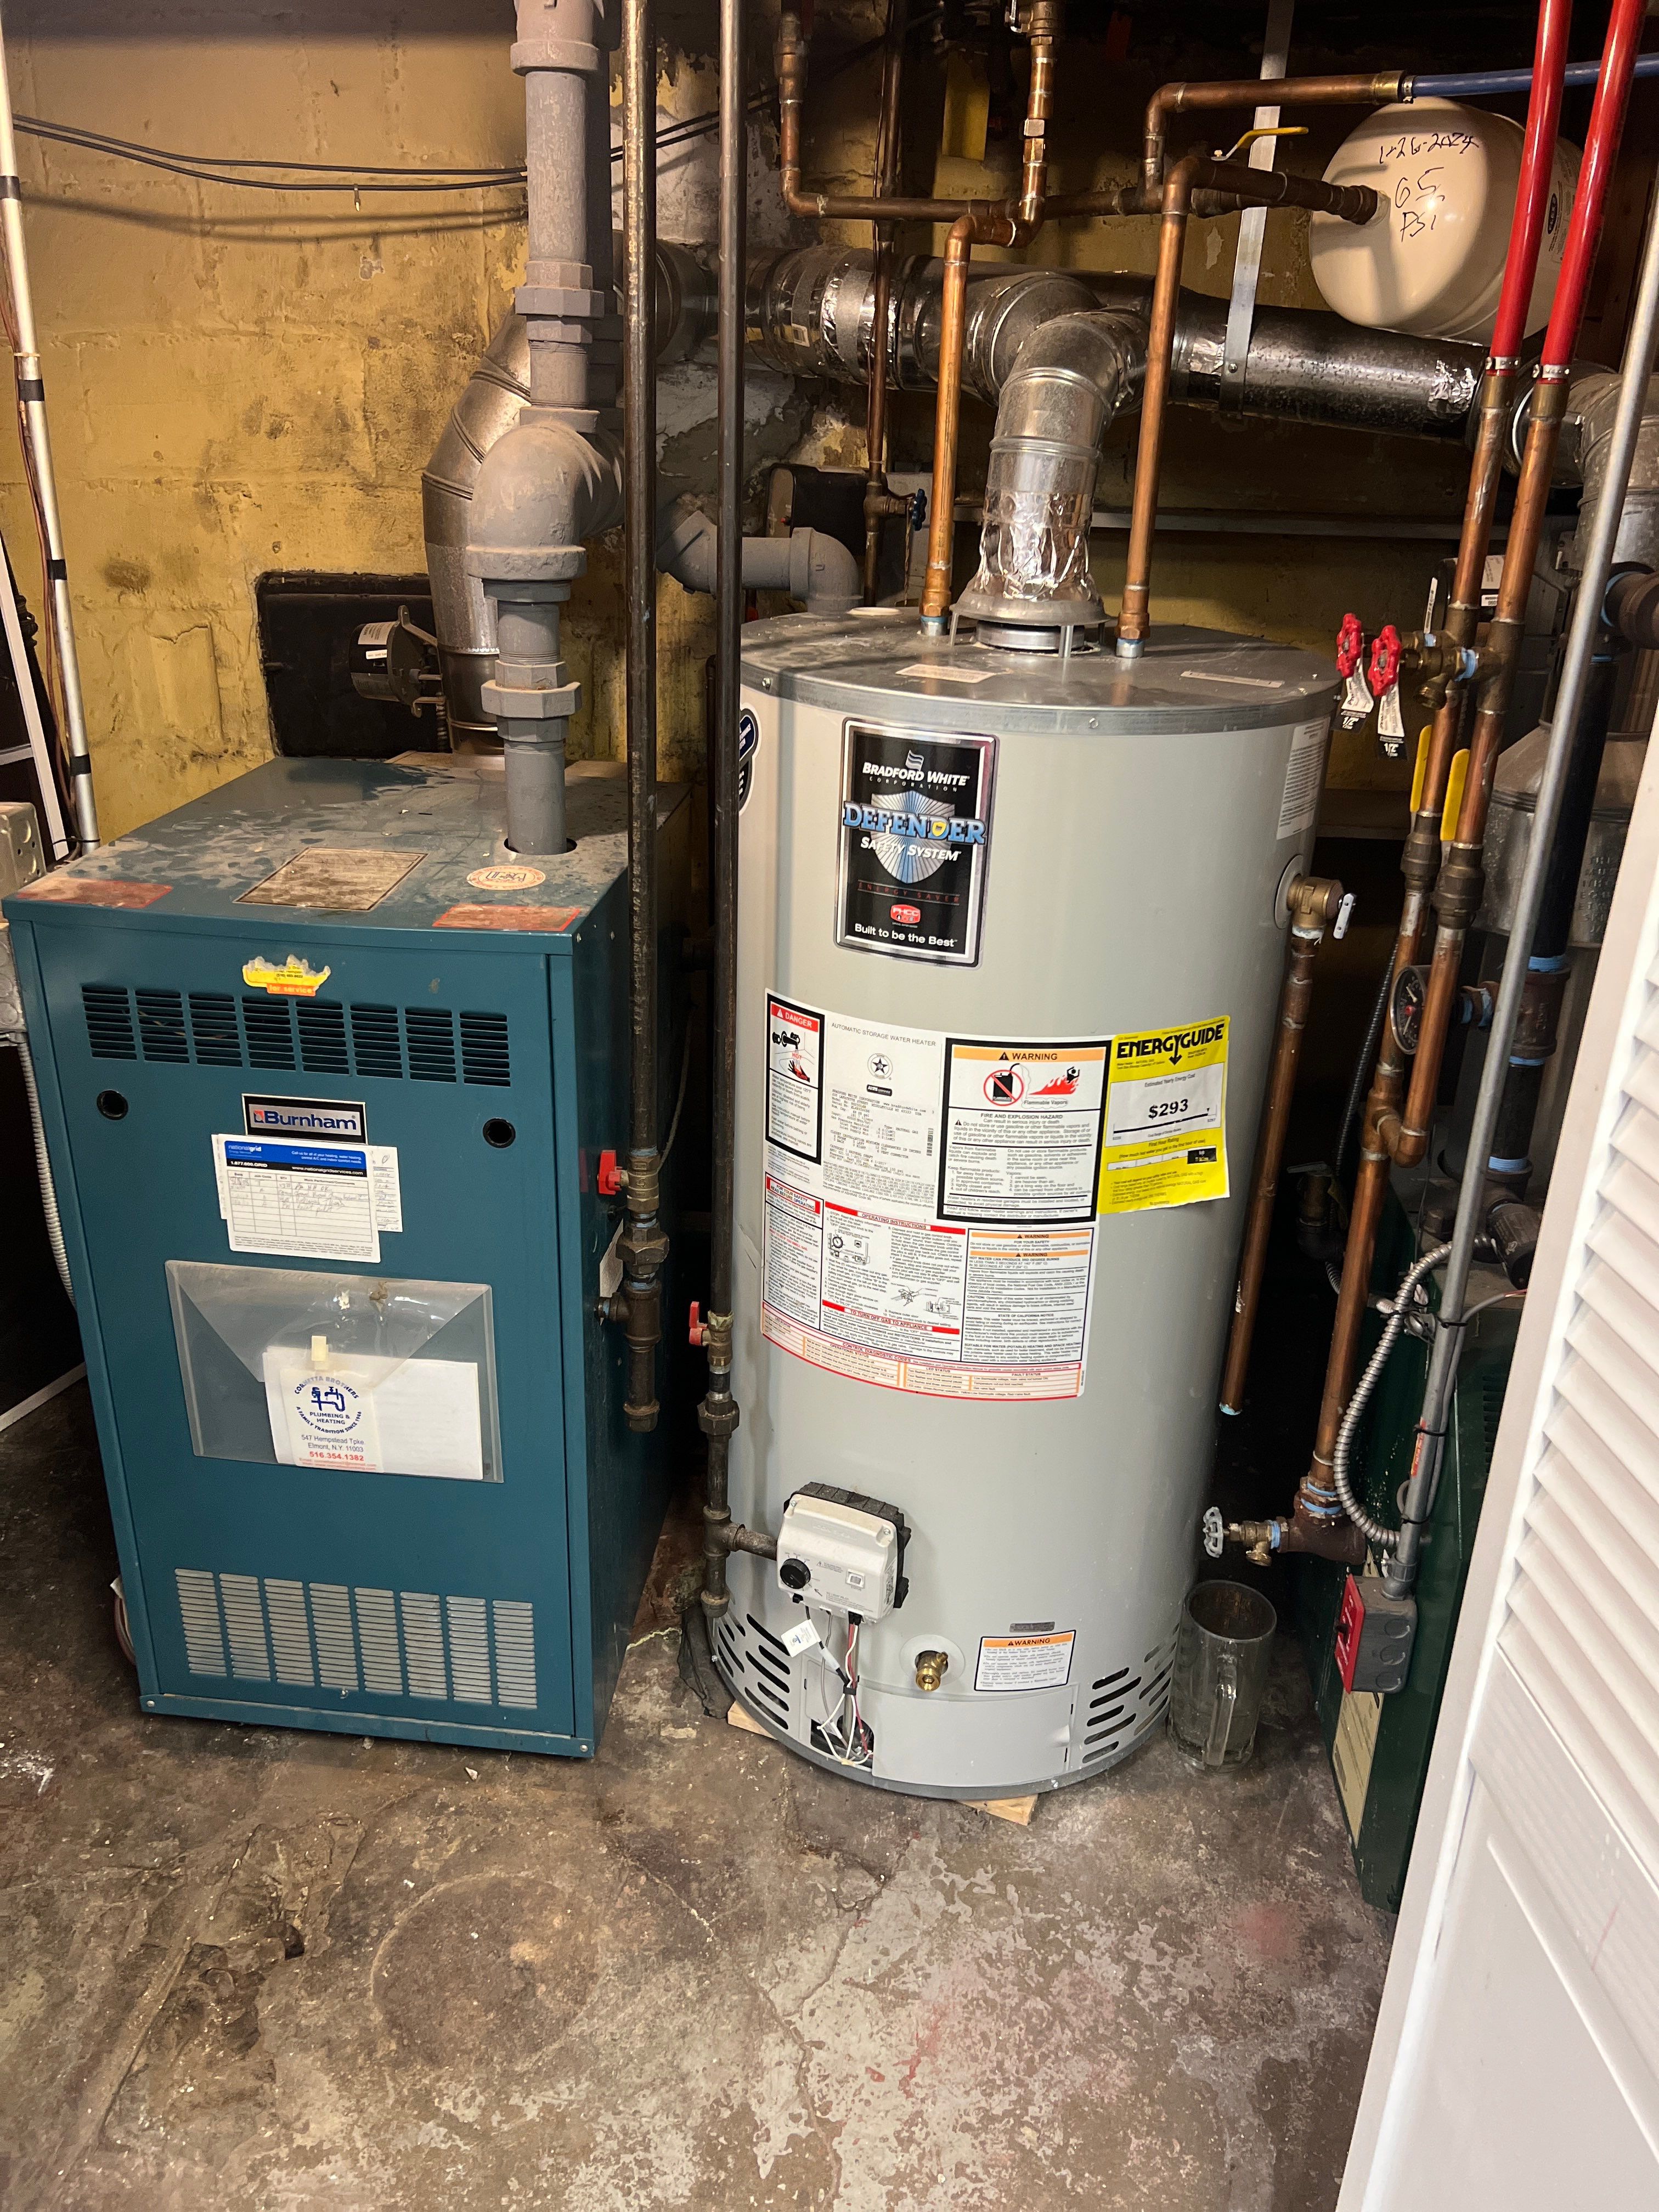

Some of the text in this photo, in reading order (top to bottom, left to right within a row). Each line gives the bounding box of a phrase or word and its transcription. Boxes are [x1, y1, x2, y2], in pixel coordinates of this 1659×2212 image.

[862, 762, 967, 786] BRADFORD WHITE
[869, 776, 957, 792] CORPORATION
[843, 800, 987, 845] DEFENDER
[860, 837, 959, 861] SAFETY SYSTEM
[855, 924, 954, 947] Built to be the Best
[785, 1012, 812, 1028] DANGER
[832, 1023, 861, 1034] AUTOMATIC
[862, 1030, 889, 1040] STORAGE
[1116, 1023, 1224, 1059] ENERGYGUIDE
[792, 1052, 802, 1060] HOT
[1149, 1099, 1188, 1119] $293
[264, 1110, 357, 1131] Burnham
[291, 1166, 364, 1175] www.nationalgridservices.com
[862, 1214, 926, 1229] OPERATING INSTRUCTIONS
[900, 1321, 927, 1331] APPLIANCE
[295, 1376, 359, 1399] CORNETTA BROTHERS
[298, 1410, 314, 1426] FAMILY
[315, 1425, 345, 1434] TRADITION
[345, 1421, 357, 1432] SINCE
[314, 1436, 348, 1444] Hempstead
[309, 1451, 364, 1461] 516.354.1382
